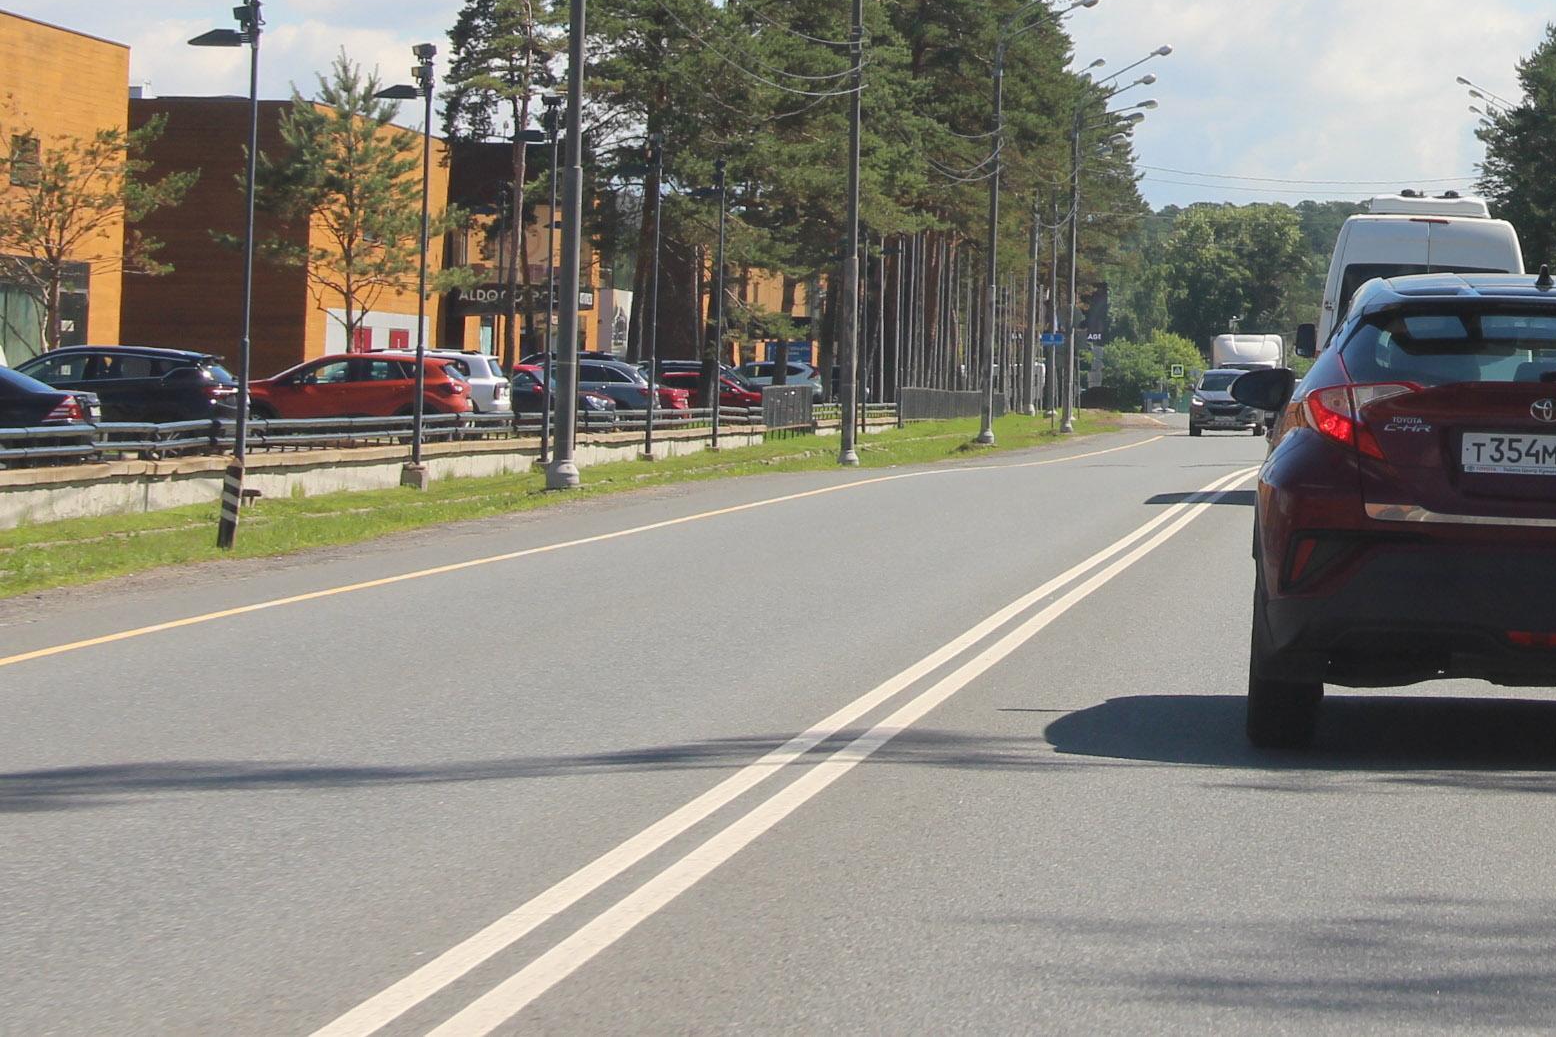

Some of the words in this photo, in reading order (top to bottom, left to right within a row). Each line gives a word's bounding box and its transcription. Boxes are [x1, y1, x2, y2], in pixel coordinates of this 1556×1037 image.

[459, 290, 498, 301] ALDO
[1392, 416, 1422, 424] TOYOTA
[1384, 423, 1432, 432] C-HR
